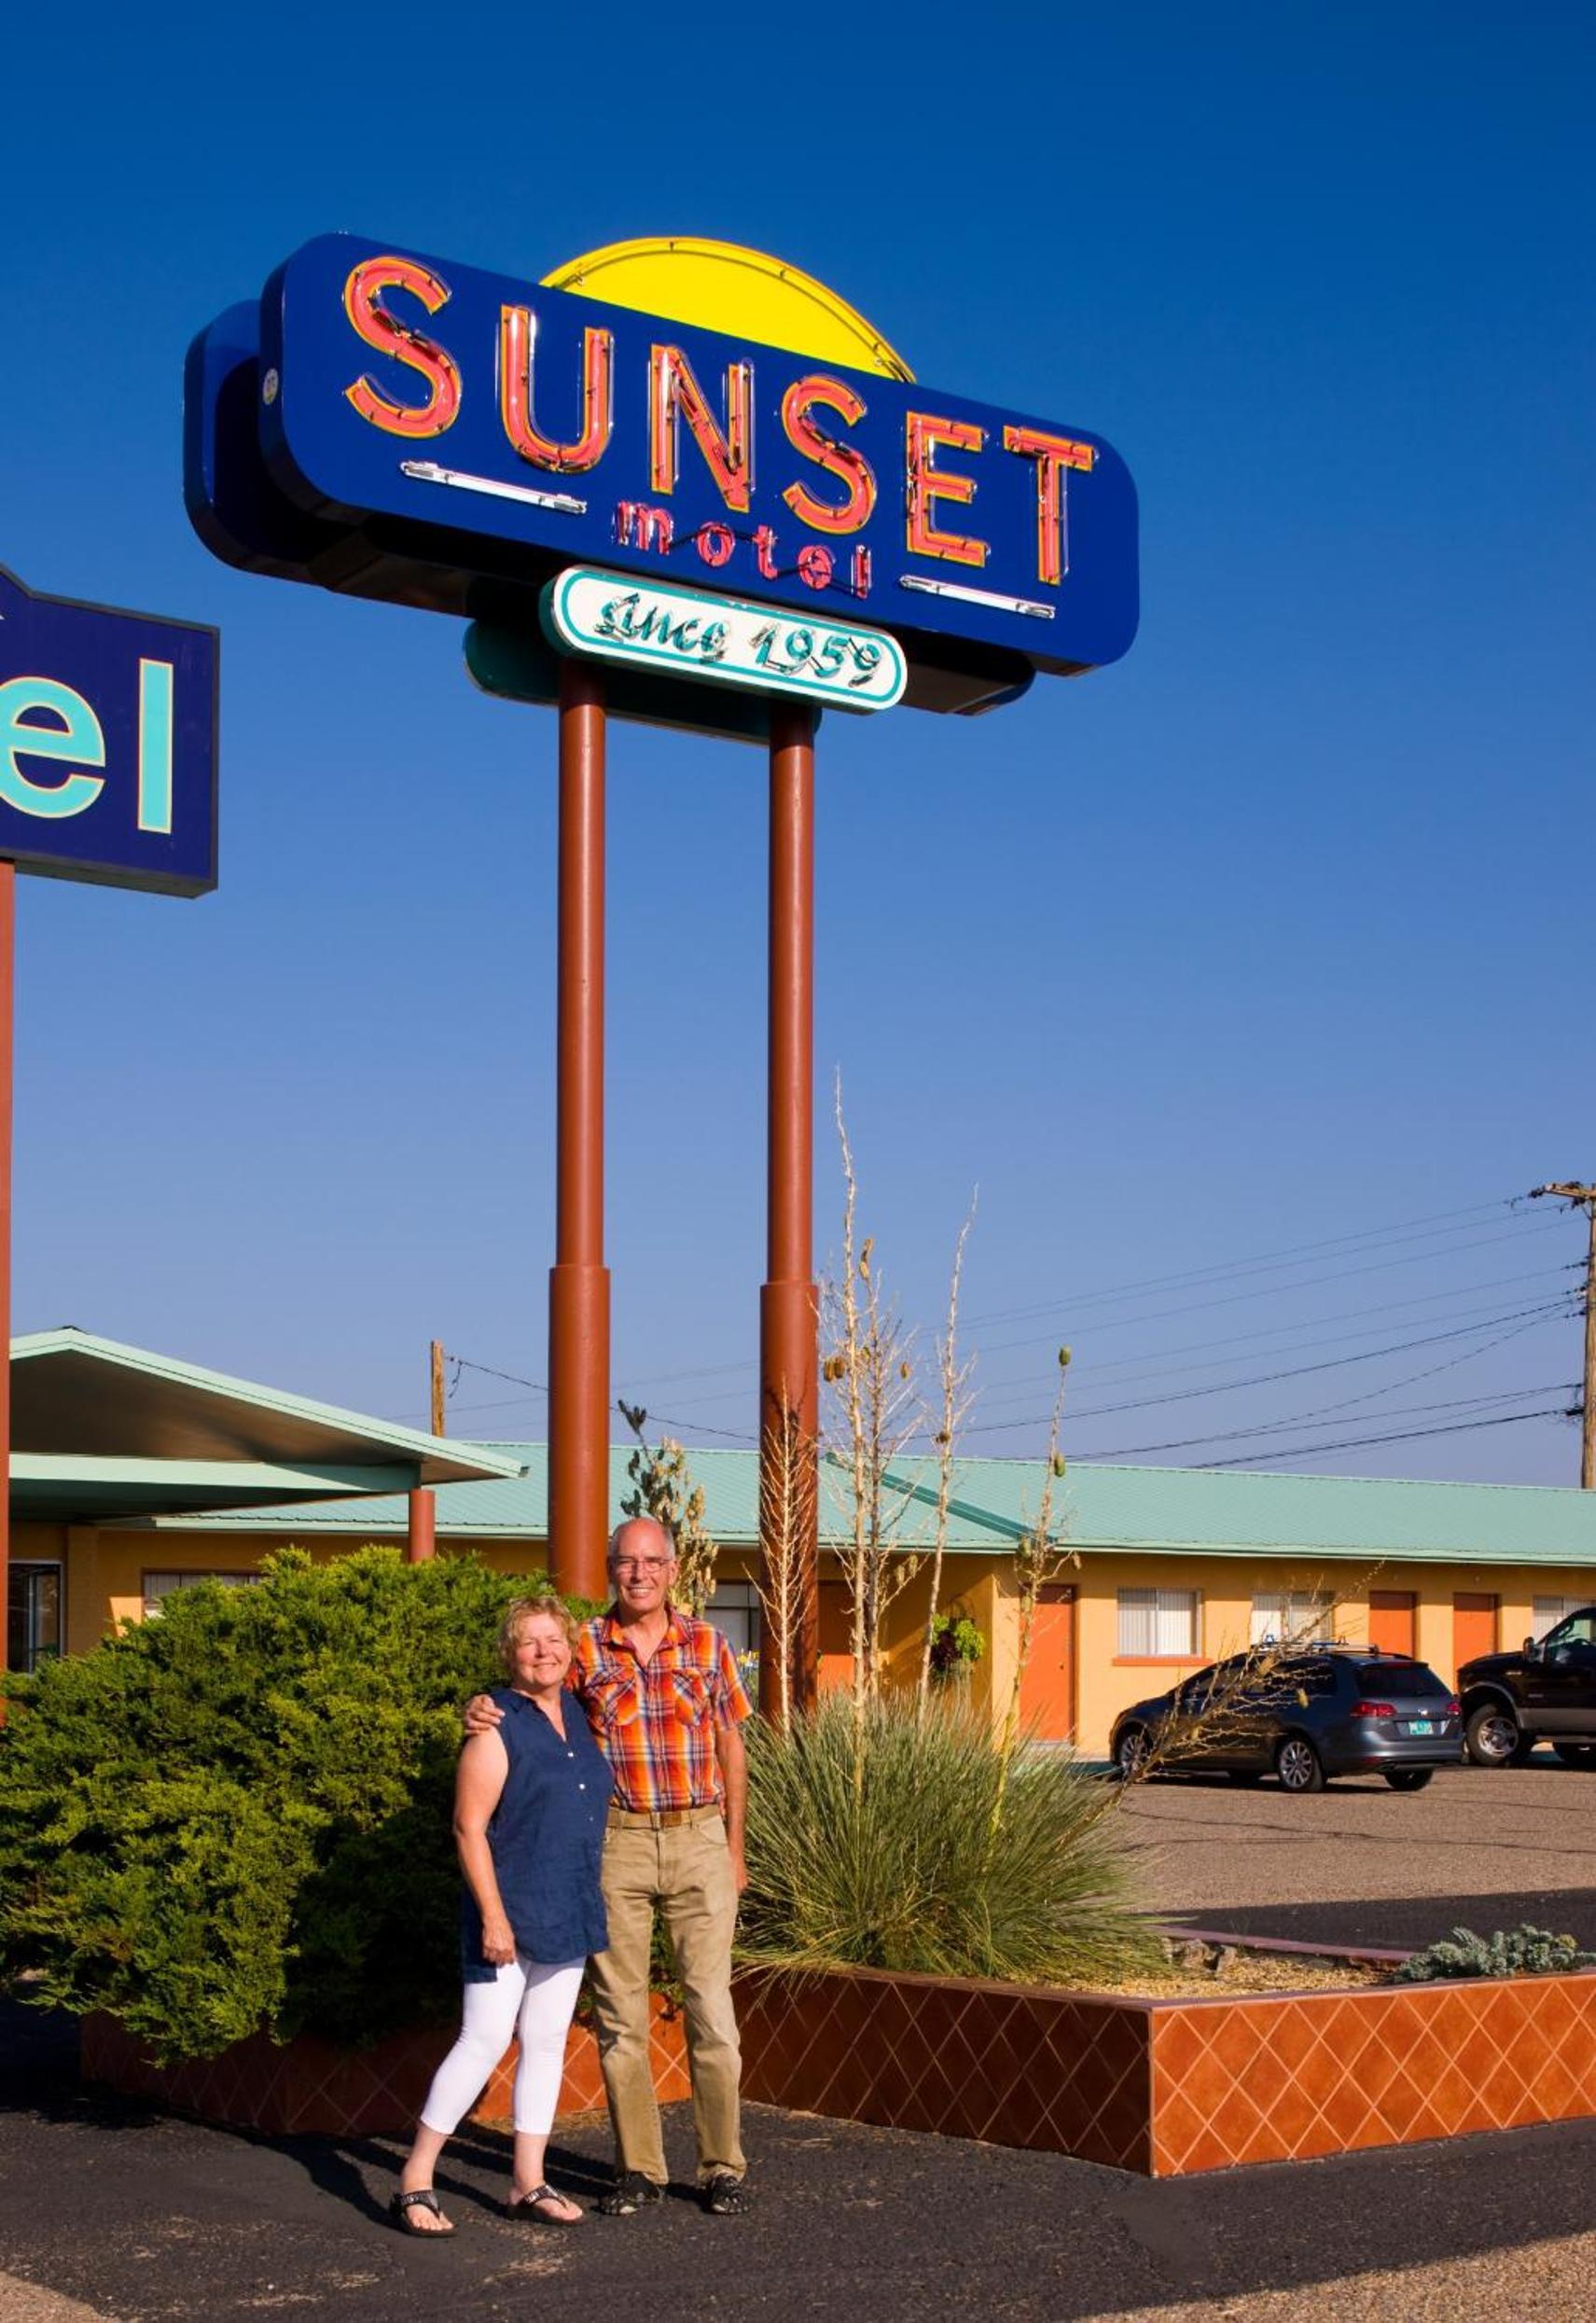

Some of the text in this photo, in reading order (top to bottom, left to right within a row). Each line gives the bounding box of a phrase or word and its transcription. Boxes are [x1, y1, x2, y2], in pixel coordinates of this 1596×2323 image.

[343, 257, 1099, 585] SUNSET
[612, 500, 875, 600] motel
[748, 622, 883, 689] 1959
